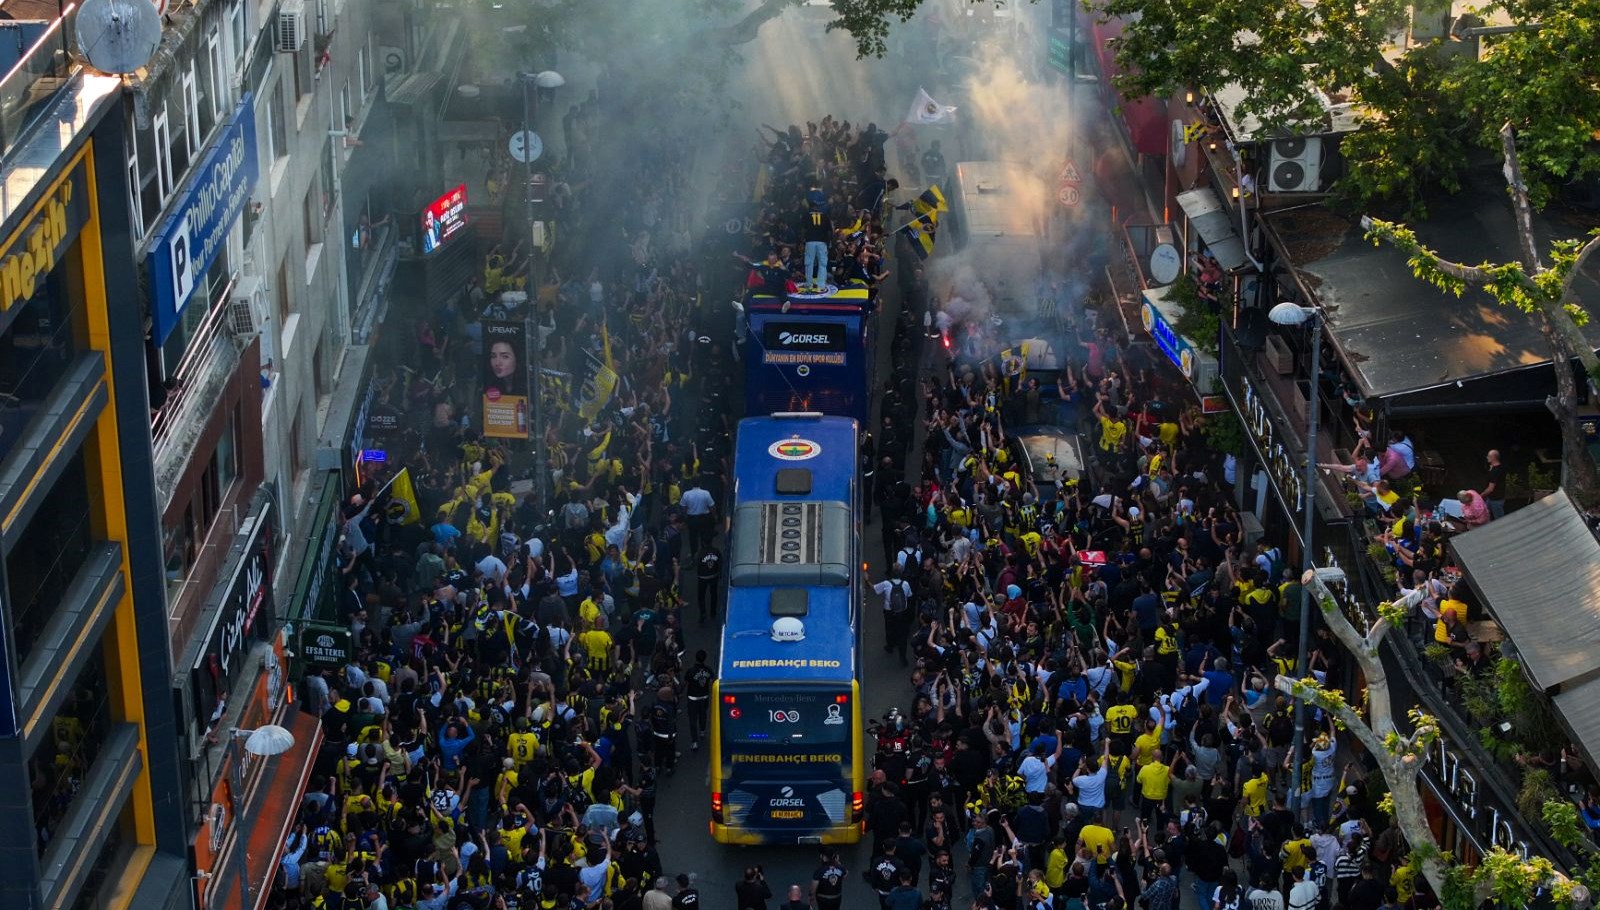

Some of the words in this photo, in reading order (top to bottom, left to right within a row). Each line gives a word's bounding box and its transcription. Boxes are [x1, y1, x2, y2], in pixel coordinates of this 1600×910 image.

[187, 123, 245, 238] PhillipCapital
[1062, 190, 1077, 202] 30
[811, 213, 822, 226] 11
[487, 326, 516, 335] URBAN
[305, 645, 324, 655] EFSA
[324, 647, 347, 658] TEKEL
[732, 659, 807, 668] FENERBAHÇE
[809, 660, 841, 668] BEKO
[1114, 716, 1131, 731] 10
[731, 754, 807, 764] FENERBAHÇE
[809, 754, 842, 763] BEKO
[433, 796, 447, 806] 24
